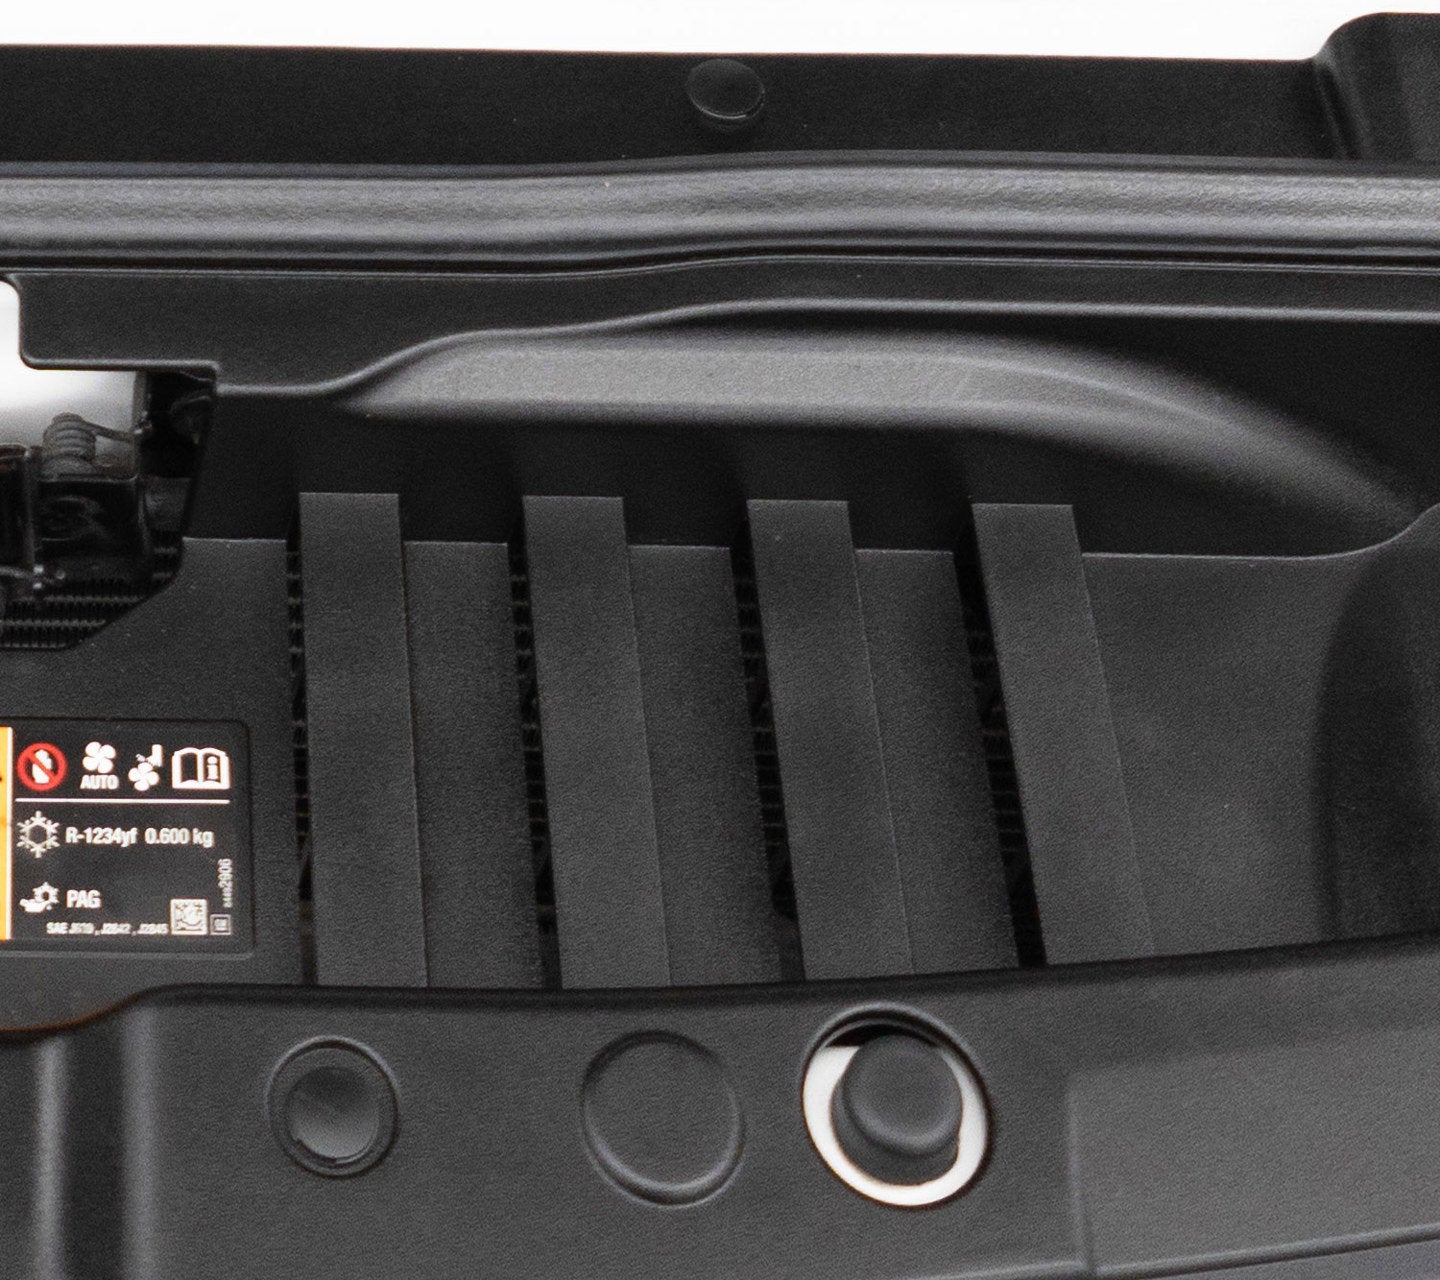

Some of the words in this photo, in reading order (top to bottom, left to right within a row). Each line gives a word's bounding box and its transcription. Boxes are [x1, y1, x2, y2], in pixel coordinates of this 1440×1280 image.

[80, 775, 119, 790] AUTO
[65, 828, 137, 848] R-1234yf
[145, 829, 189, 845] 0.600
[193, 829, 214, 848] kg
[66, 889, 101, 909] PAG
